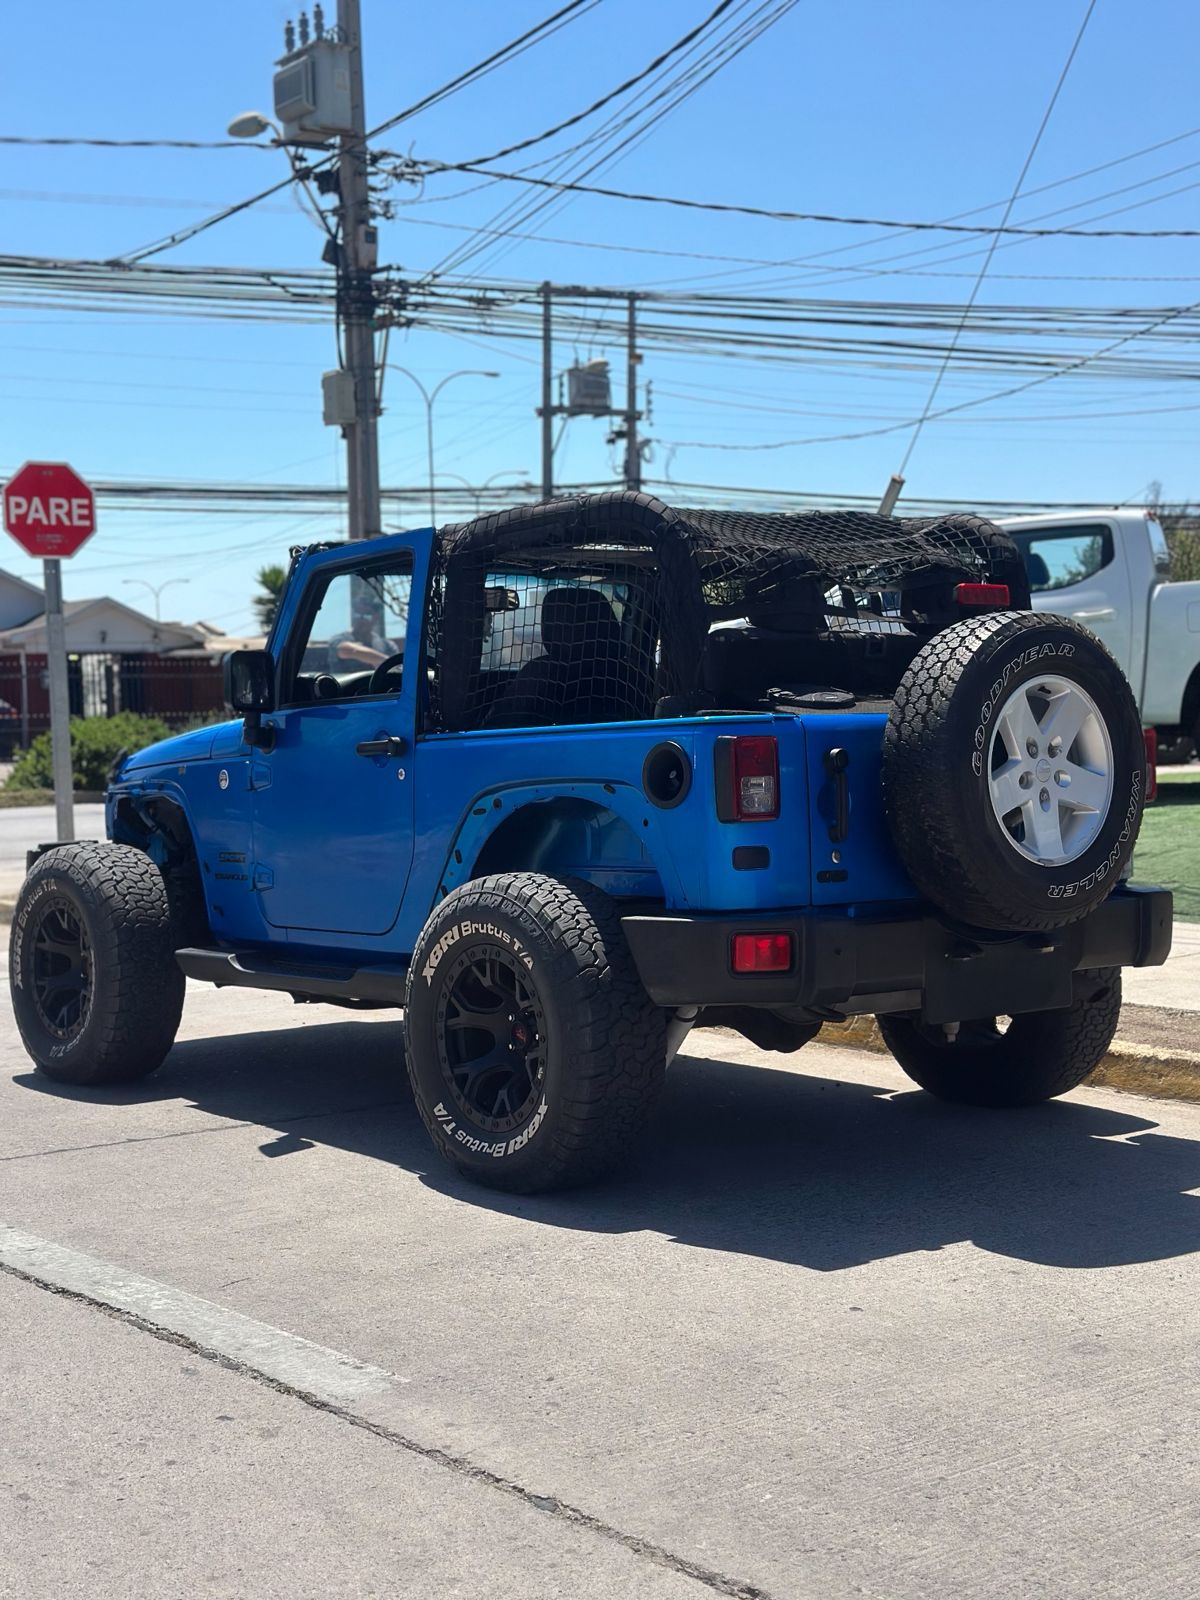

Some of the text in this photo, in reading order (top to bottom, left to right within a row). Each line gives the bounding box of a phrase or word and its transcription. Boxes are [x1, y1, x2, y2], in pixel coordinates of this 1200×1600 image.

[8, 495, 91, 527] PARE
[972, 643, 1076, 777] GOODYEAR
[1047, 770, 1141, 897] WRANGLER
[17, 886, 44, 930] Brutus
[41, 878, 57, 893] T/A
[422, 920, 534, 987] XBRI Brutus T/A
[433, 1093, 548, 1157] XBRI Brutus T/A
